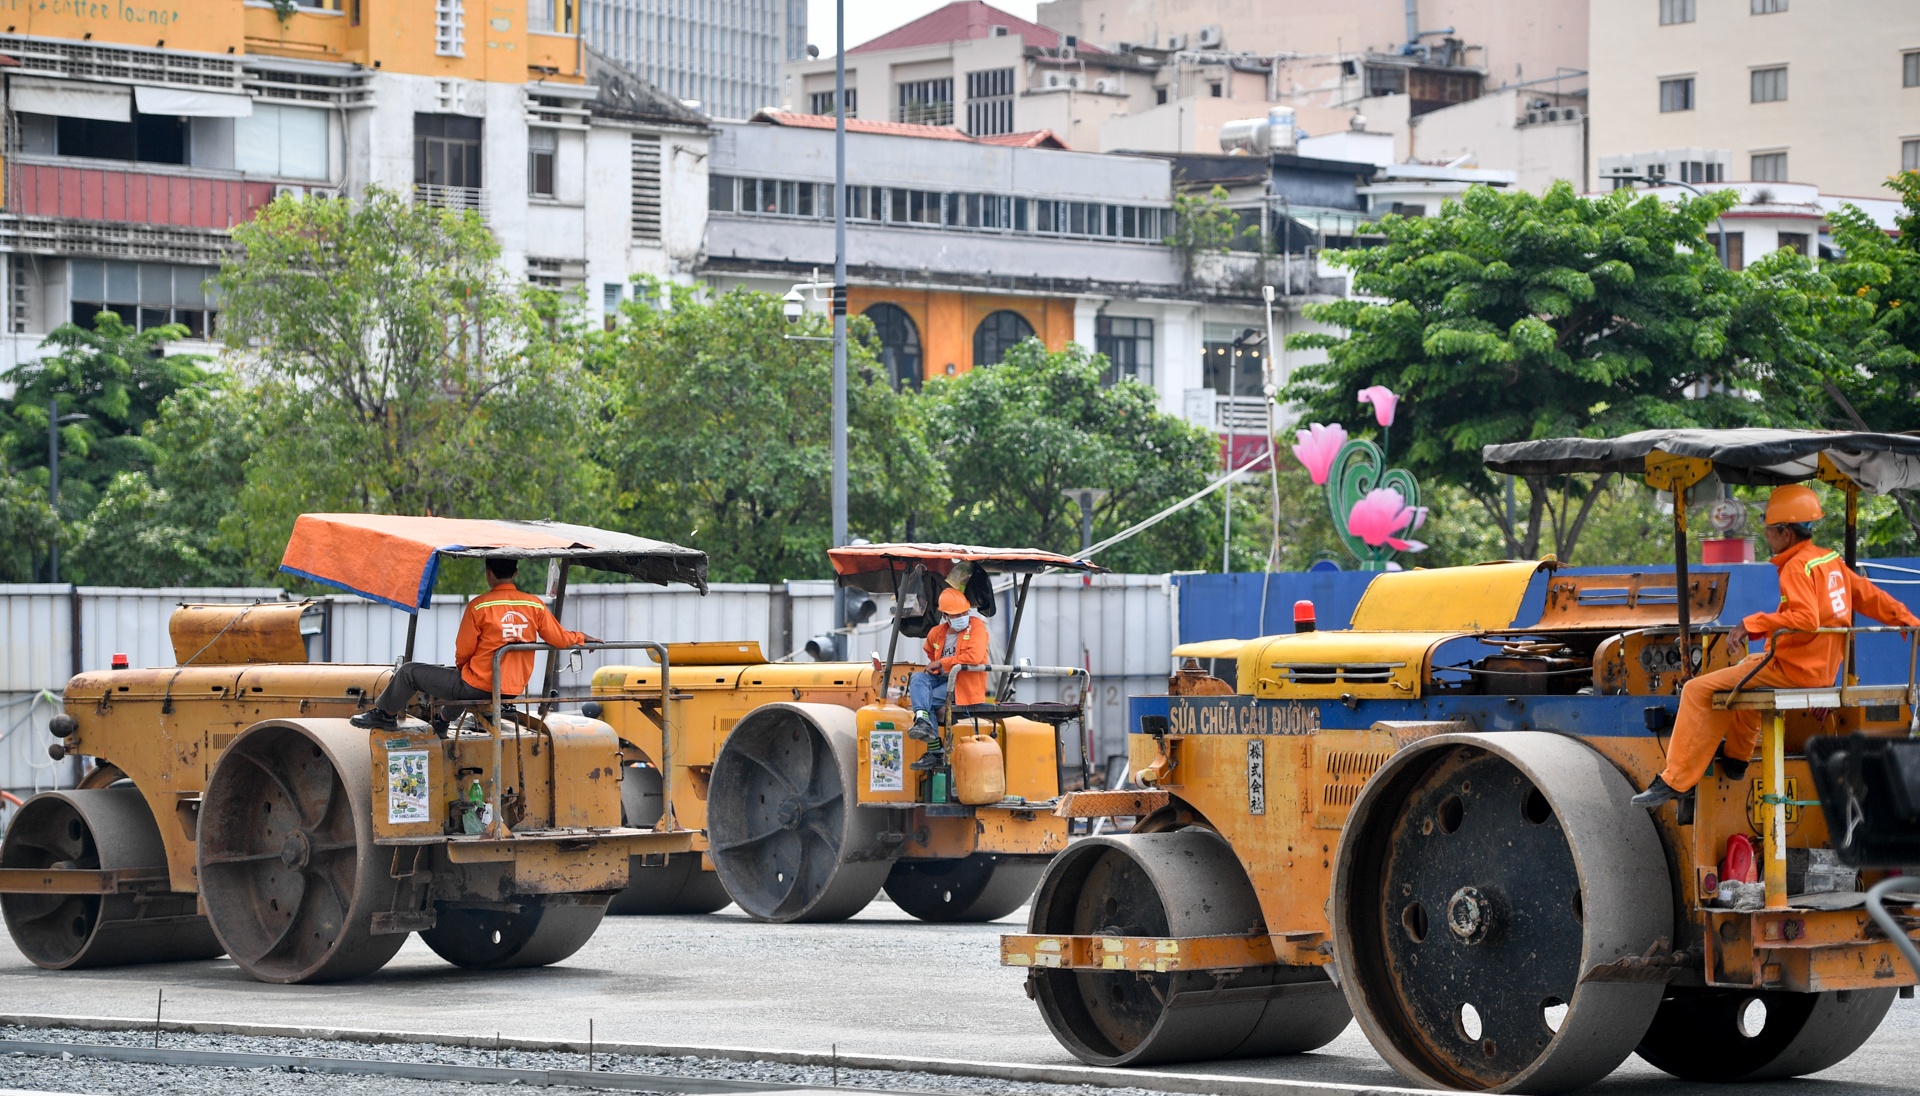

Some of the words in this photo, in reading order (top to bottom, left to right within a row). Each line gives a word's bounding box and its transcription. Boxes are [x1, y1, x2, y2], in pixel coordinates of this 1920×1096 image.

[1170, 698, 1197, 734] SỬA
[1200, 701, 1237, 734] CHỮA
[1249, 743, 1263, 811] 株式会社
